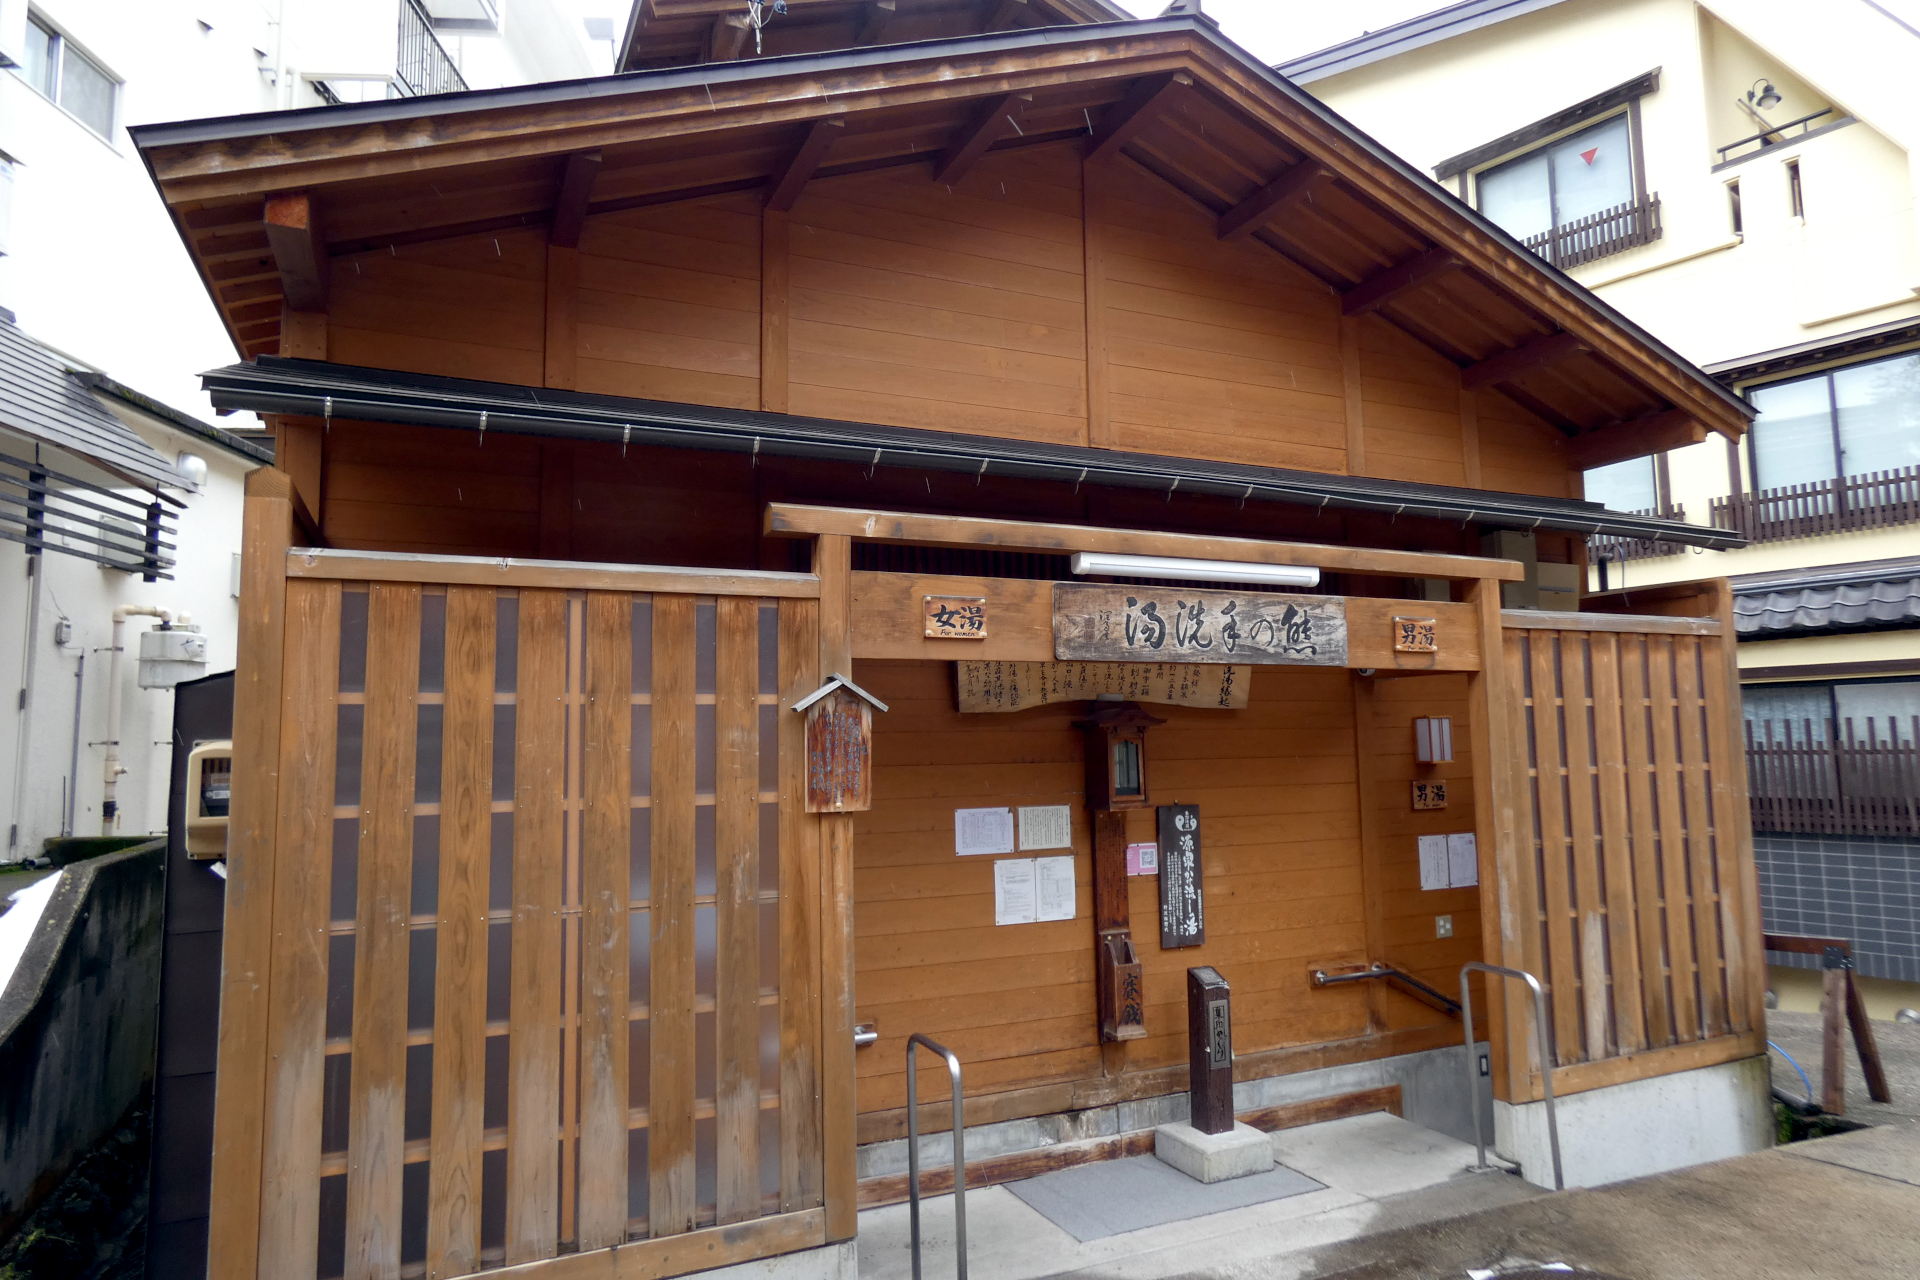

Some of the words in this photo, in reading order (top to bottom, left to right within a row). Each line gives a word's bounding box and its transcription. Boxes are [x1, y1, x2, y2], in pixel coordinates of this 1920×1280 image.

[930, 604, 984, 631] 女湯
[1125, 596, 1317, 655] 熊の手洗湯
[940, 629, 951, 637] For
[1401, 623, 1435, 646] 男湯
[1416, 784, 1446, 802] 男湯
[1180, 834, 1198, 936] 源泉かけ流しの湯
